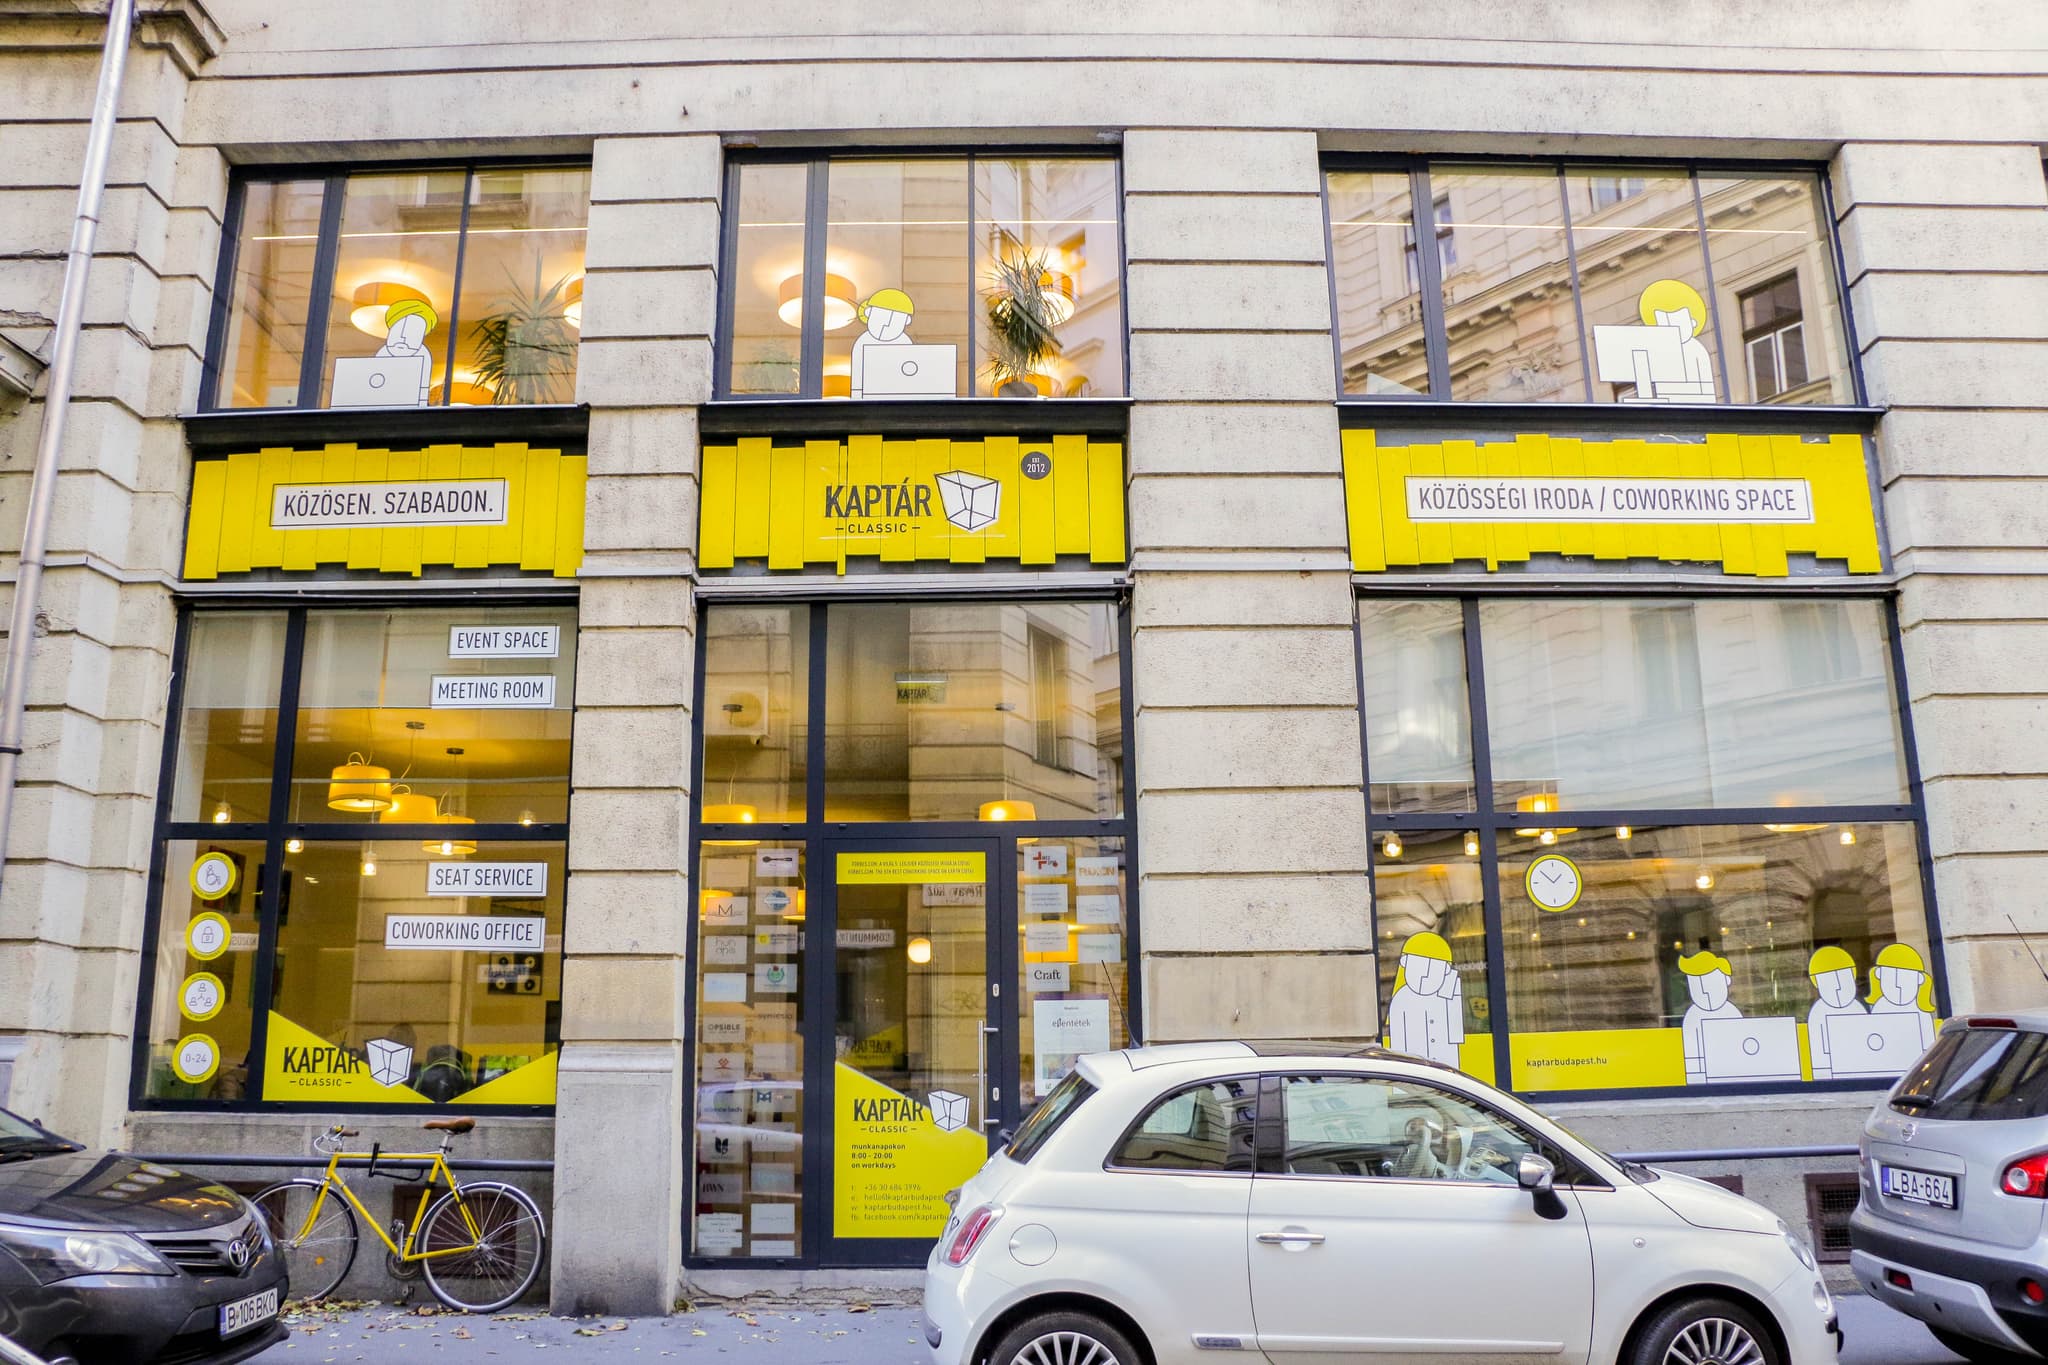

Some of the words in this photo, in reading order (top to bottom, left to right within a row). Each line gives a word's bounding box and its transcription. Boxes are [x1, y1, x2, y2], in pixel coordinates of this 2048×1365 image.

[1027, 463, 1046, 473] 2012
[284, 490, 377, 517] KÖZÖSEN.
[384, 489, 494, 514] SZABADON.
[824, 477, 932, 518] KAPTÁR
[1419, 483, 1527, 510] KÖZÖSSÉGI
[1533, 487, 1594, 511] IRODA
[1612, 488, 1730, 512] COWORKING
[1736, 489, 1797, 512] SPACE
[847, 523, 908, 534] CLASSIC
[457, 632, 500, 649] EVENT
[504, 631, 549, 648] SPACE
[438, 682, 498, 699] MEETING
[503, 681, 544, 698] ROOM
[435, 868, 470, 886] SEAT
[474, 868, 534, 886] SERVICE
[392, 921, 480, 940] COWORKING
[484, 923, 534, 941] OFFICE
[1033, 970, 1061, 980] Craft
[1526, 1057, 1607, 1067] kaptarbudapest.hu
[298, 1078, 343, 1087] CLASSIC
[868, 1125, 909, 1133] CLASSIC
[851, 1143, 906, 1151] munkanapokon
[873, 1152, 893, 1160] 20:00
[861, 1162, 896, 1170] workdays
[1892, 1170, 1949, 1202] LBA-664
